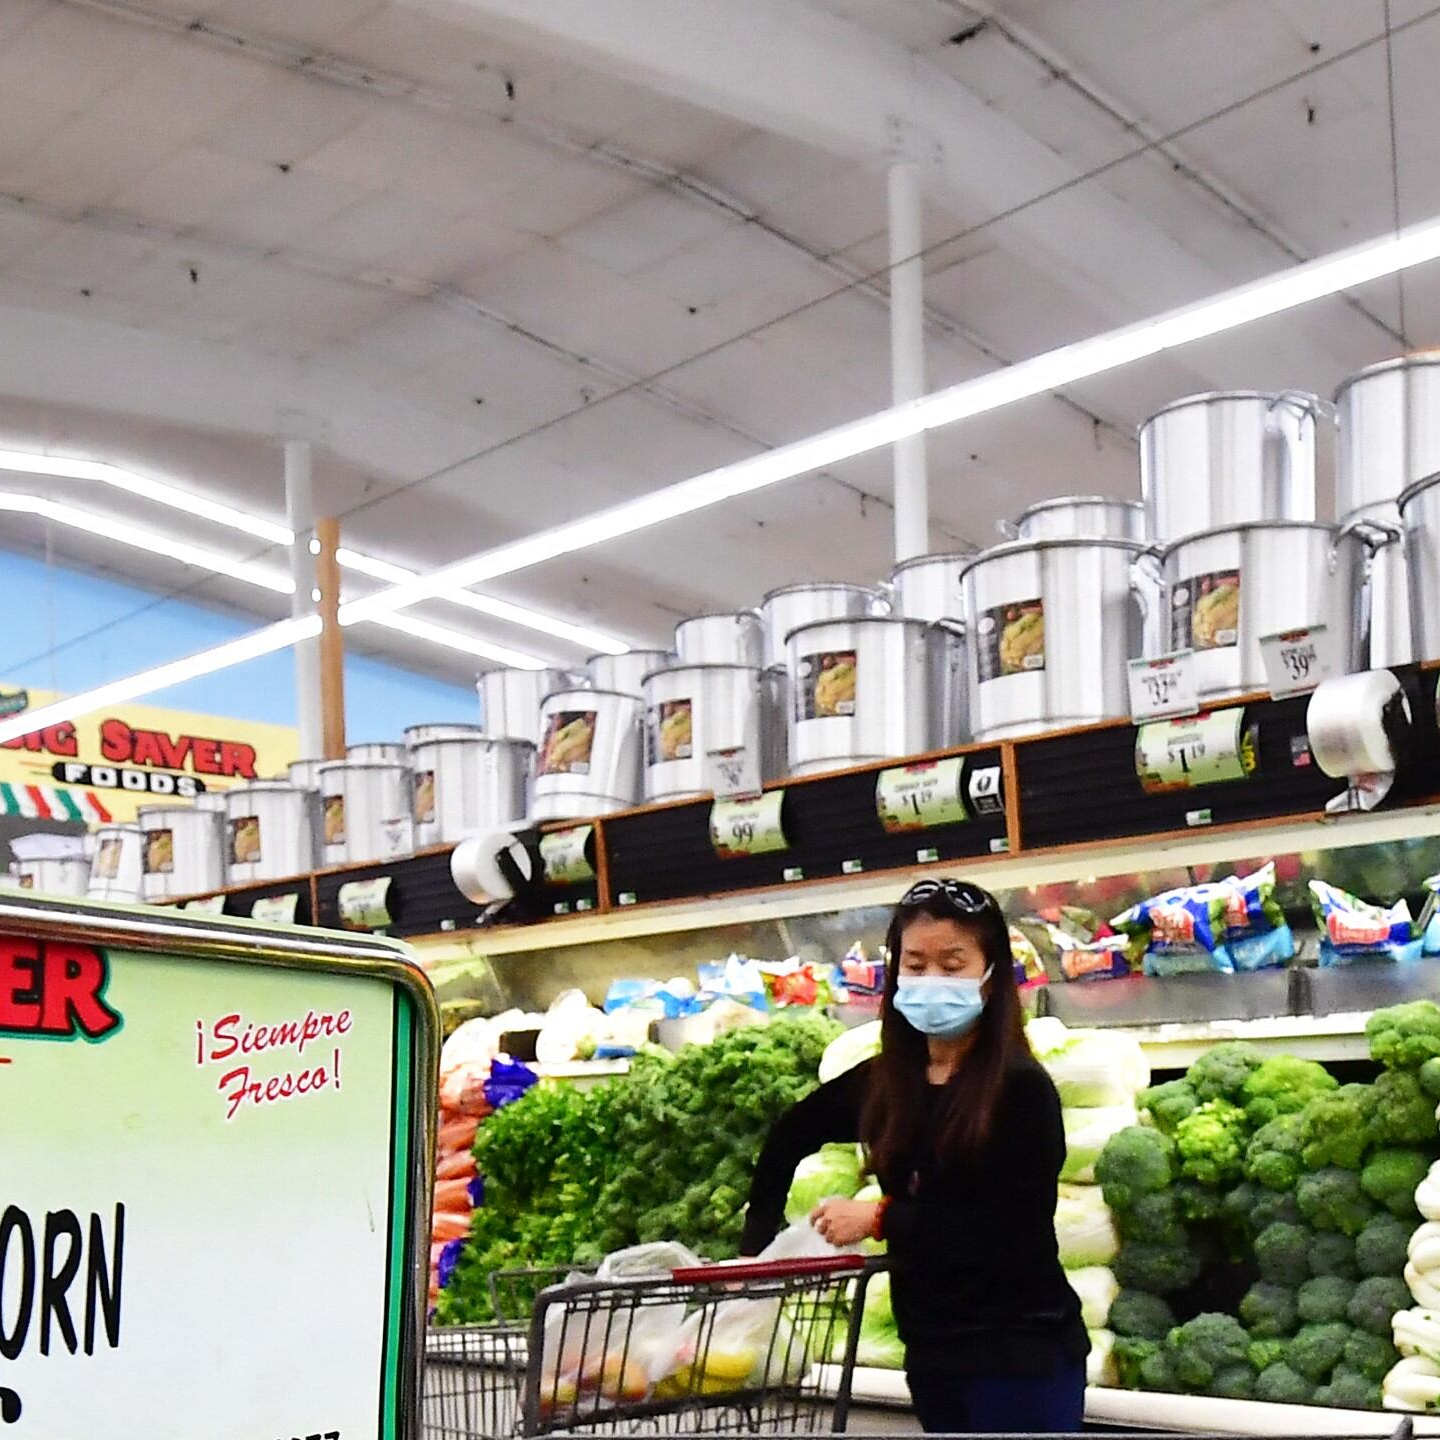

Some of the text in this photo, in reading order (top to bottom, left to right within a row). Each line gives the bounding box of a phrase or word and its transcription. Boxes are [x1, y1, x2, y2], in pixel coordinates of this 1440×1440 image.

[100, 718, 259, 779] SAVER
[63, 763, 198, 797] FOODS
[193, 1008, 354, 1066] ¡Siempre
[217, 1046, 343, 1121] Fresco!
